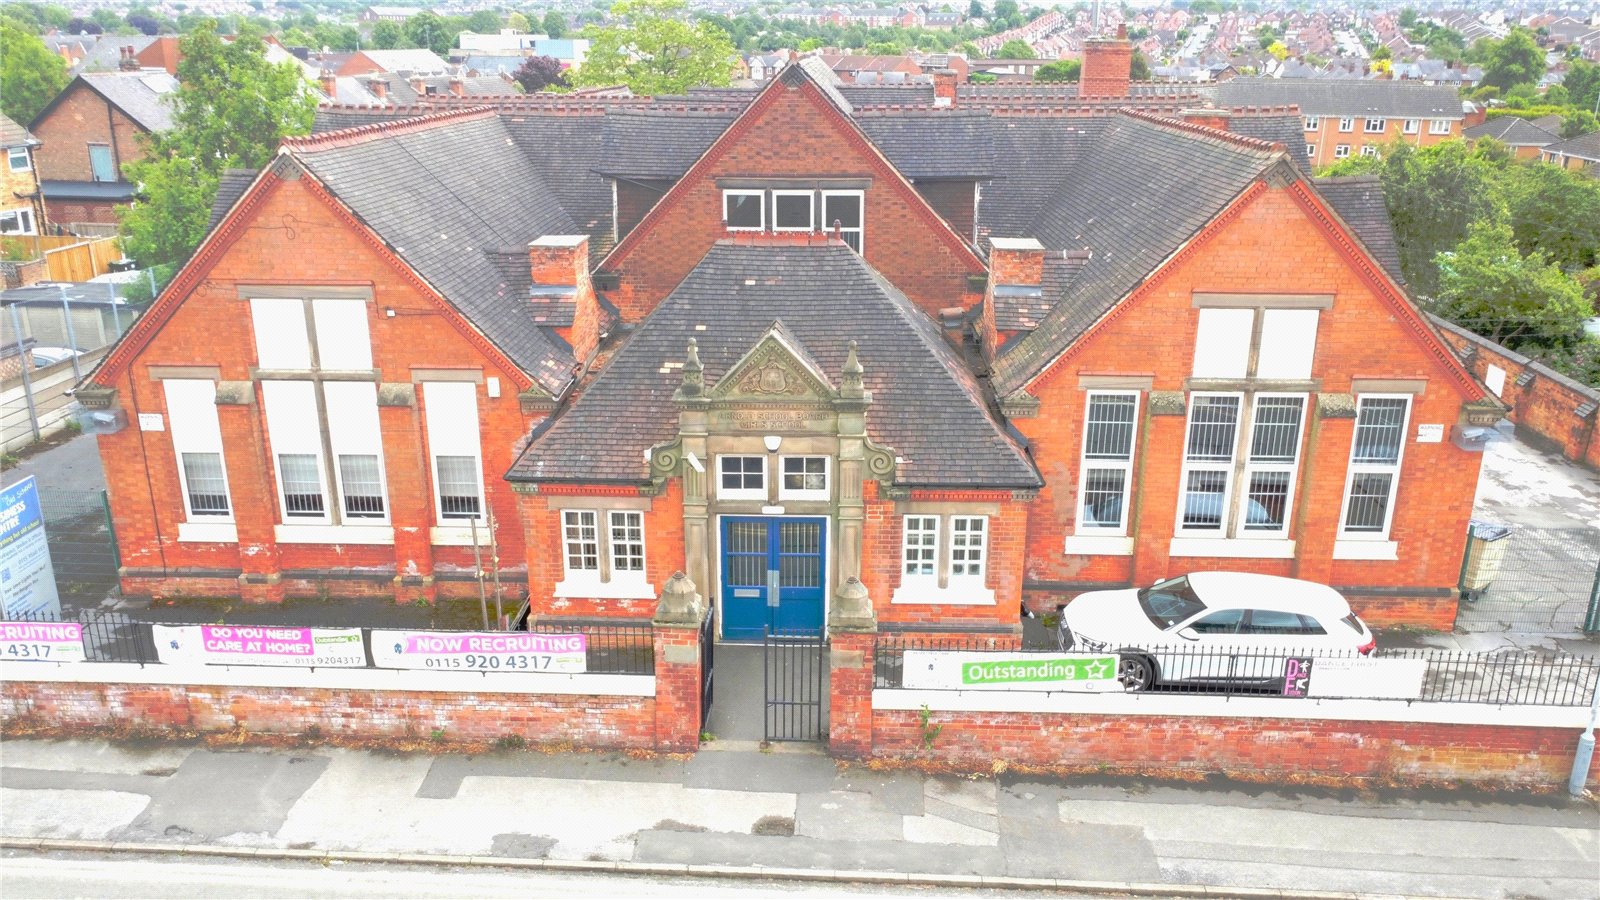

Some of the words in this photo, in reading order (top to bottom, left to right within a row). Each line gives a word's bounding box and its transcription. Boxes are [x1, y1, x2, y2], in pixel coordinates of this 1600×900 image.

[757, 411, 795, 421] SCHOOL
[770, 421, 806, 430] SCHOOL
[211, 628, 232, 638] DO
[235, 628, 263, 639] YOU
[266, 629, 302, 641] NEED
[206, 641, 242, 651] CARE
[243, 641, 263, 652] AT
[266, 643, 311, 654] HOME?
[416, 636, 464, 651] NOW
[468, 636, 581, 651] RECRUITING
[8, 644, 50, 657] 4317
[425, 658, 460, 667] 0115
[465, 654, 500, 668] 920
[505, 655, 552, 669] 4317
[968, 661, 1076, 680] Outstanding
